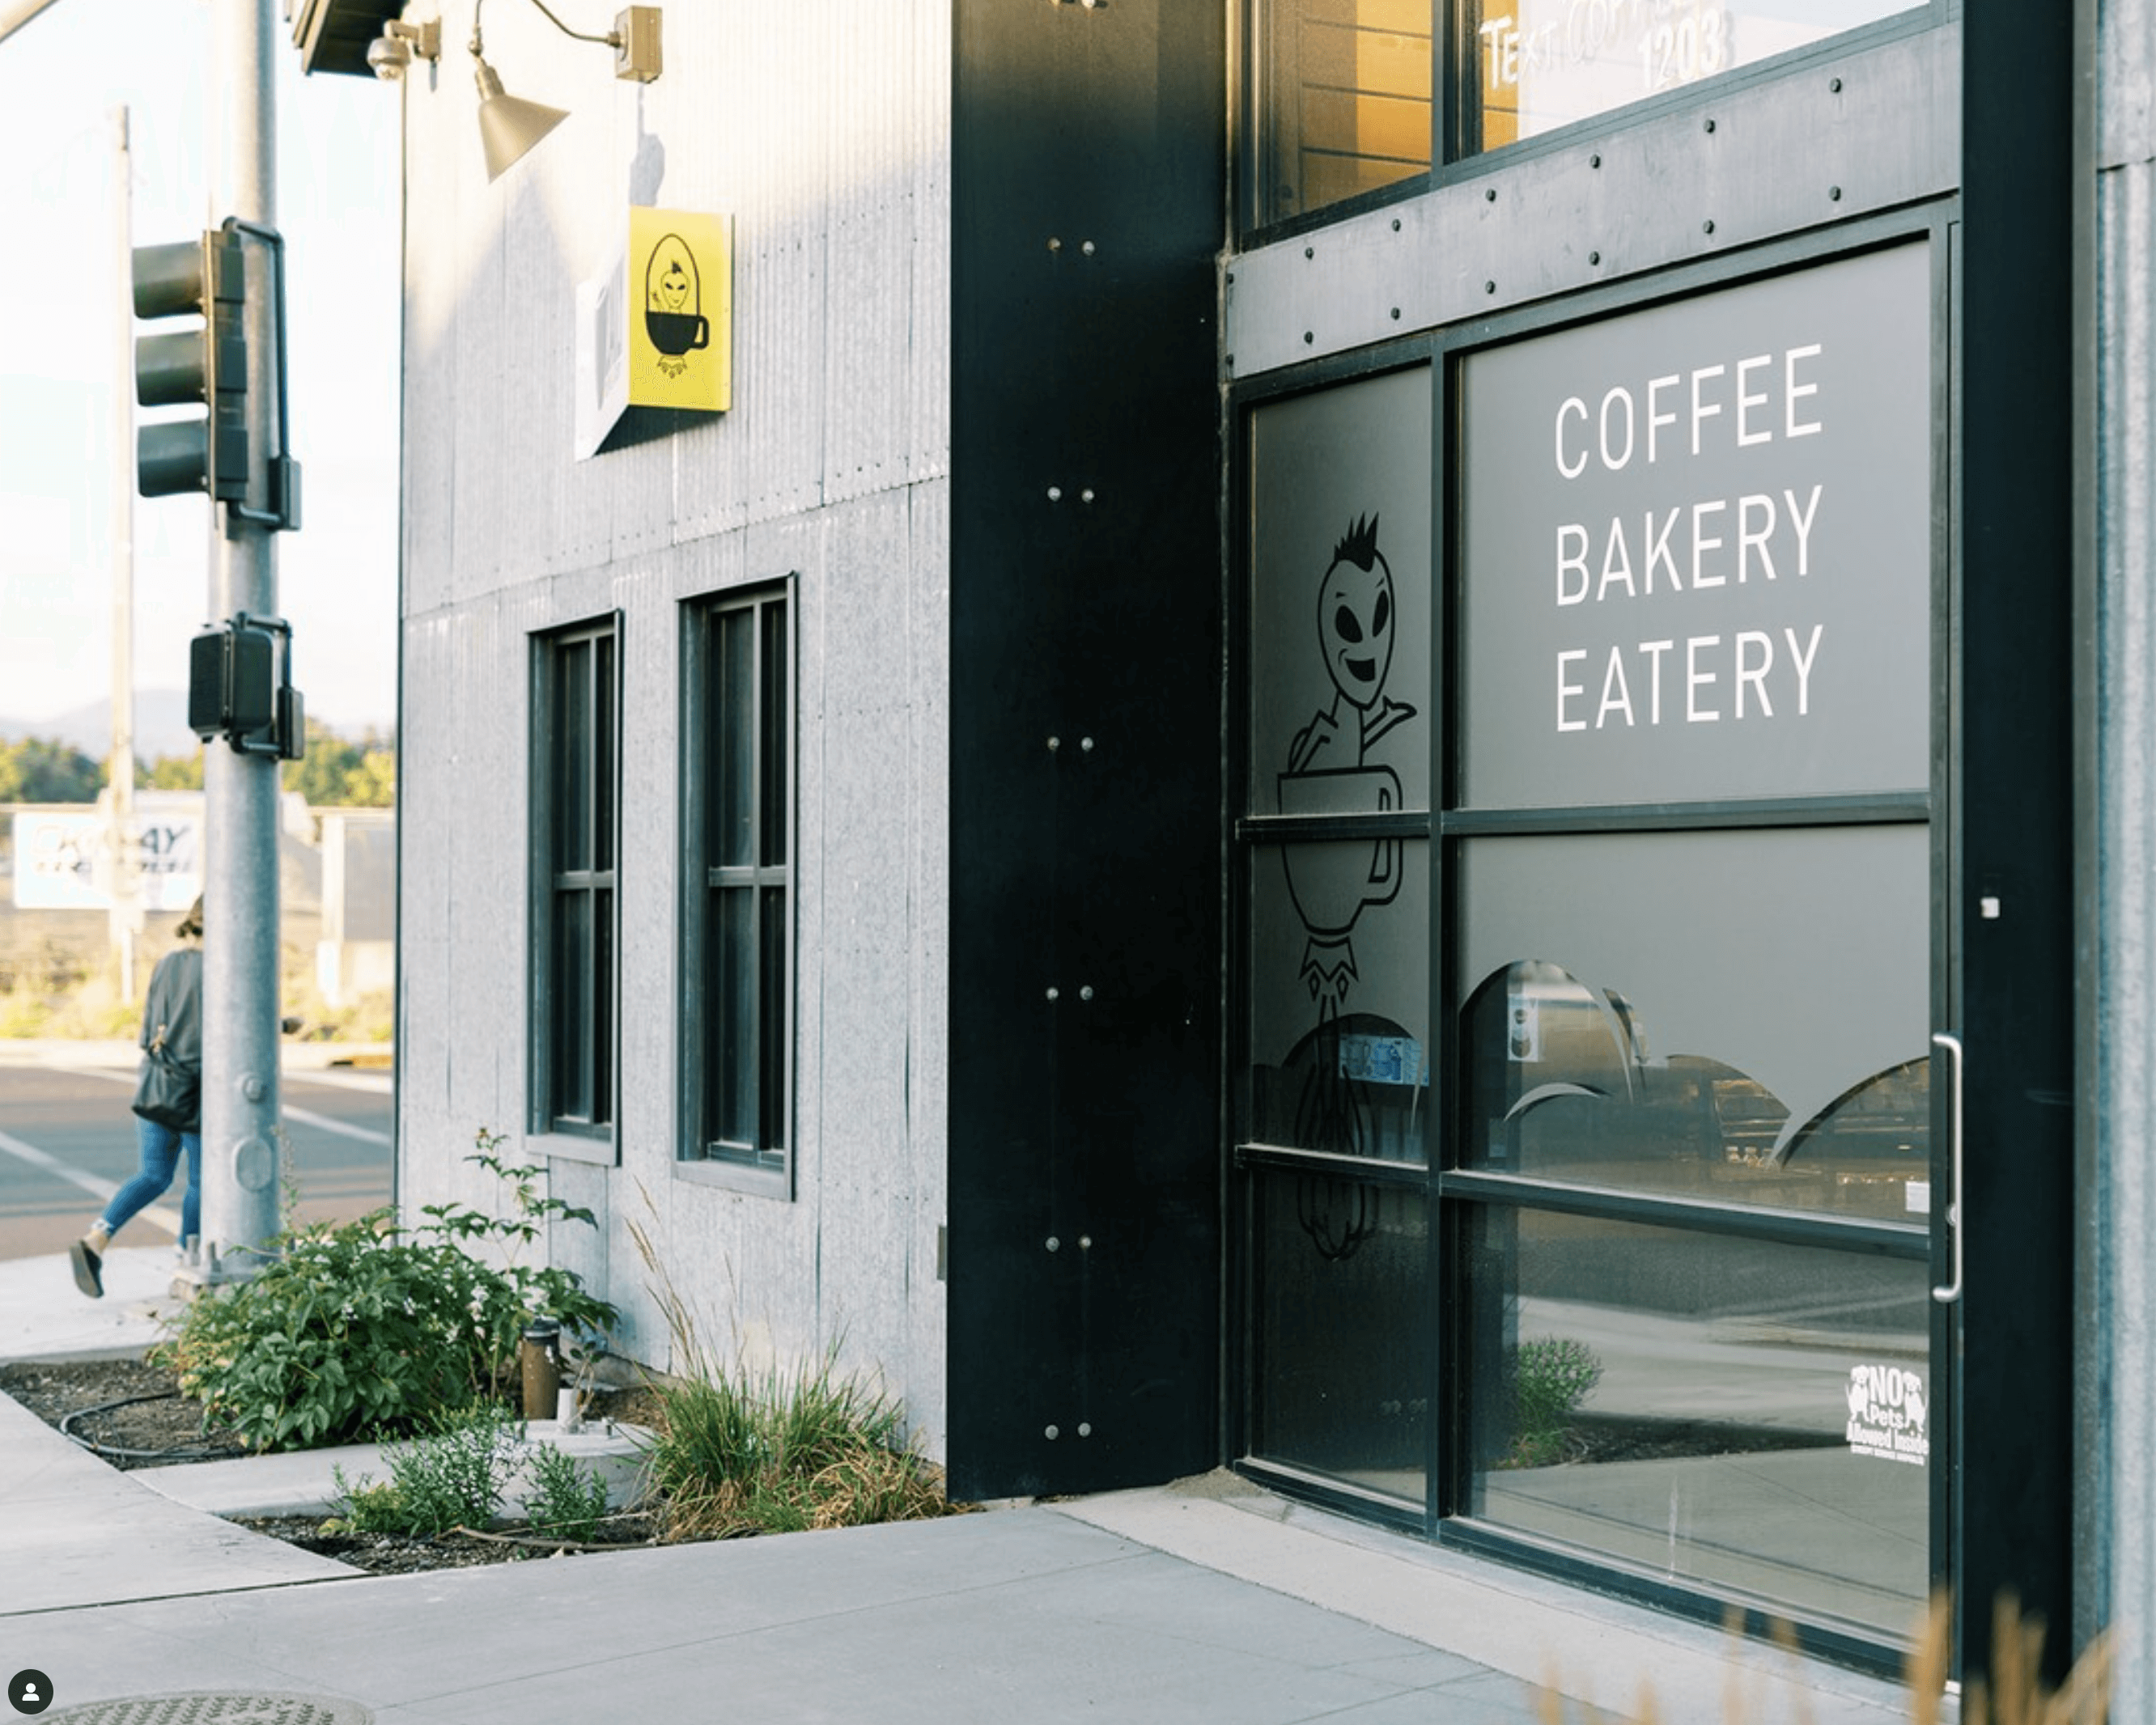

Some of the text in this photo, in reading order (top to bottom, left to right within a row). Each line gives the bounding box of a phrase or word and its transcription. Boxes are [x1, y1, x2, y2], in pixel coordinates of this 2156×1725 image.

[1637, 7, 1721, 88] 1203
[1555, 344, 1822, 479] COFFEE
[1557, 485, 1823, 606] BAKERY
[1557, 625, 1823, 732] EATERY
[1870, 1365, 1903, 1407] NO
[1870, 1403, 1904, 1429] Pets
